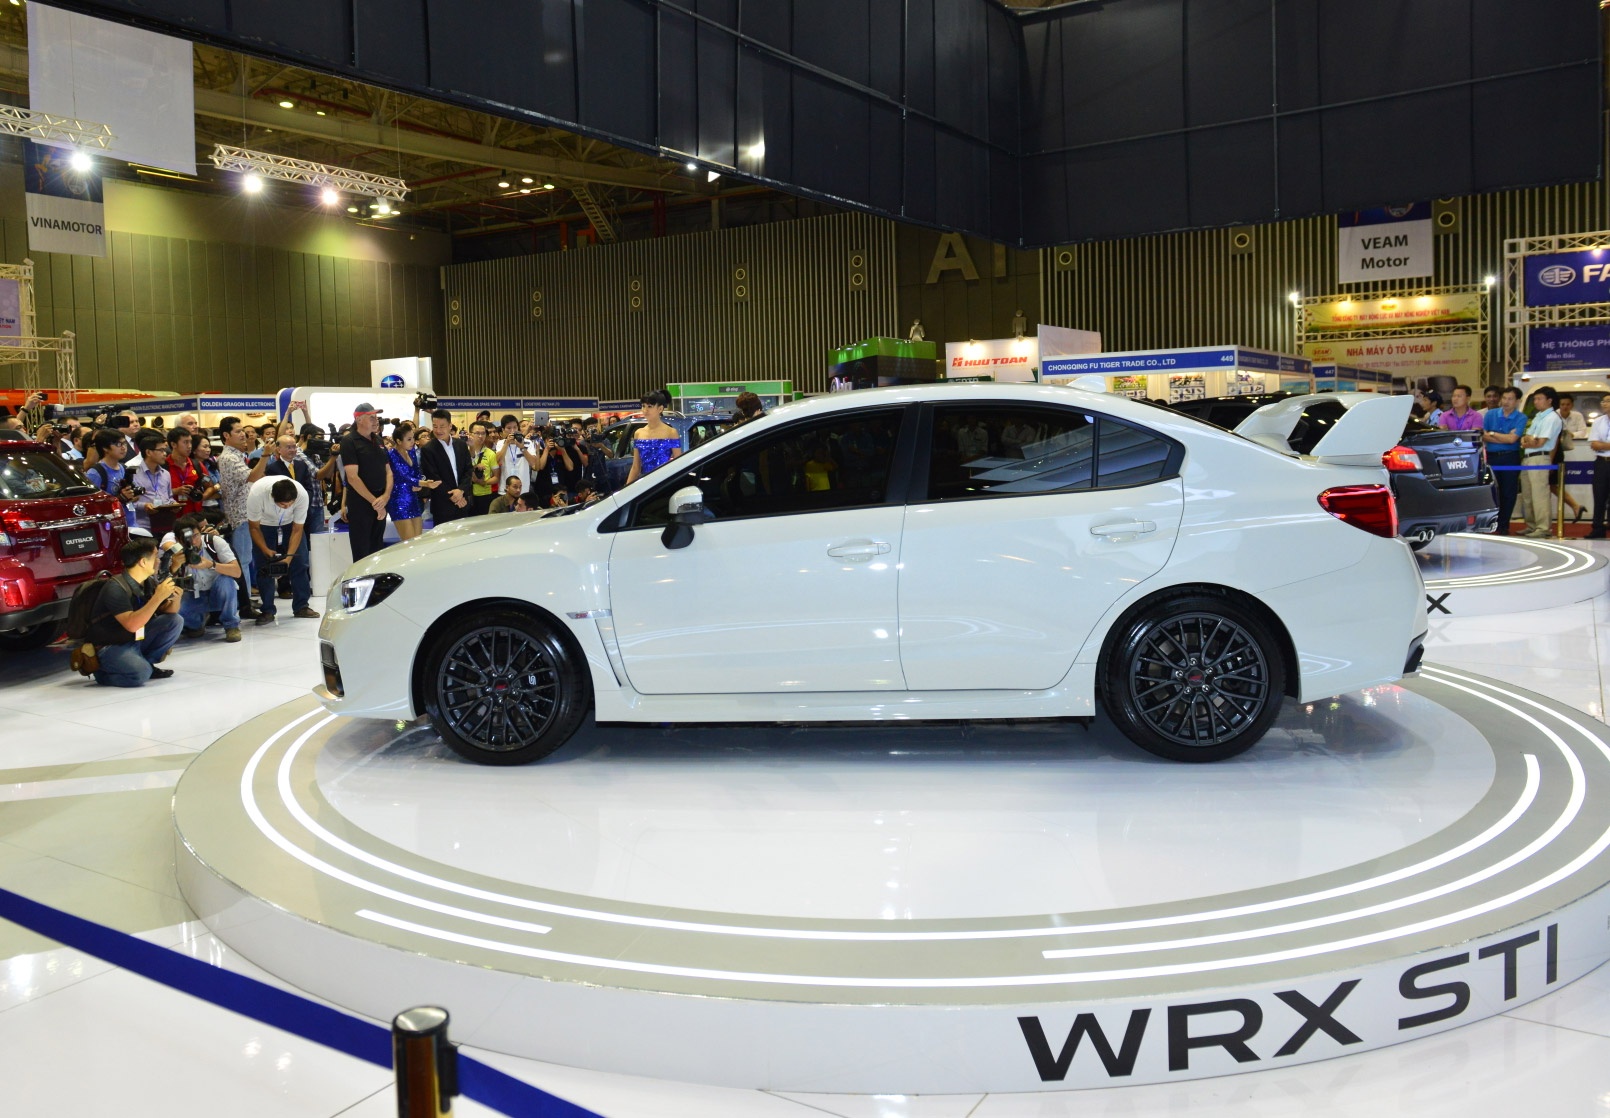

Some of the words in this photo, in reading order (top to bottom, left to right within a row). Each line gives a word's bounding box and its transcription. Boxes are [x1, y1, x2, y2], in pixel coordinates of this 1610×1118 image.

[31, 216, 102, 235] VINAMOTOR
[1361, 234, 1408, 250] VEAM
[1361, 256, 1410, 270] Motor
[1366, 345, 1385, 356] MÁY
[1387, 344, 1393, 354] Ô
[1395, 344, 1406, 354] TÔ
[1409, 344, 1433, 353] VEAM
[1048, 363, 1088, 371] CHONGQING
[1100, 361, 1120, 369] TIGER
[1122, 360, 1145, 368] TRADE
[1446, 460, 1468, 470] WRX
[65, 536, 93, 545] OUTBACK
[1017, 978, 1363, 1082] WRX
[1398, 923, 1558, 1031] STI
